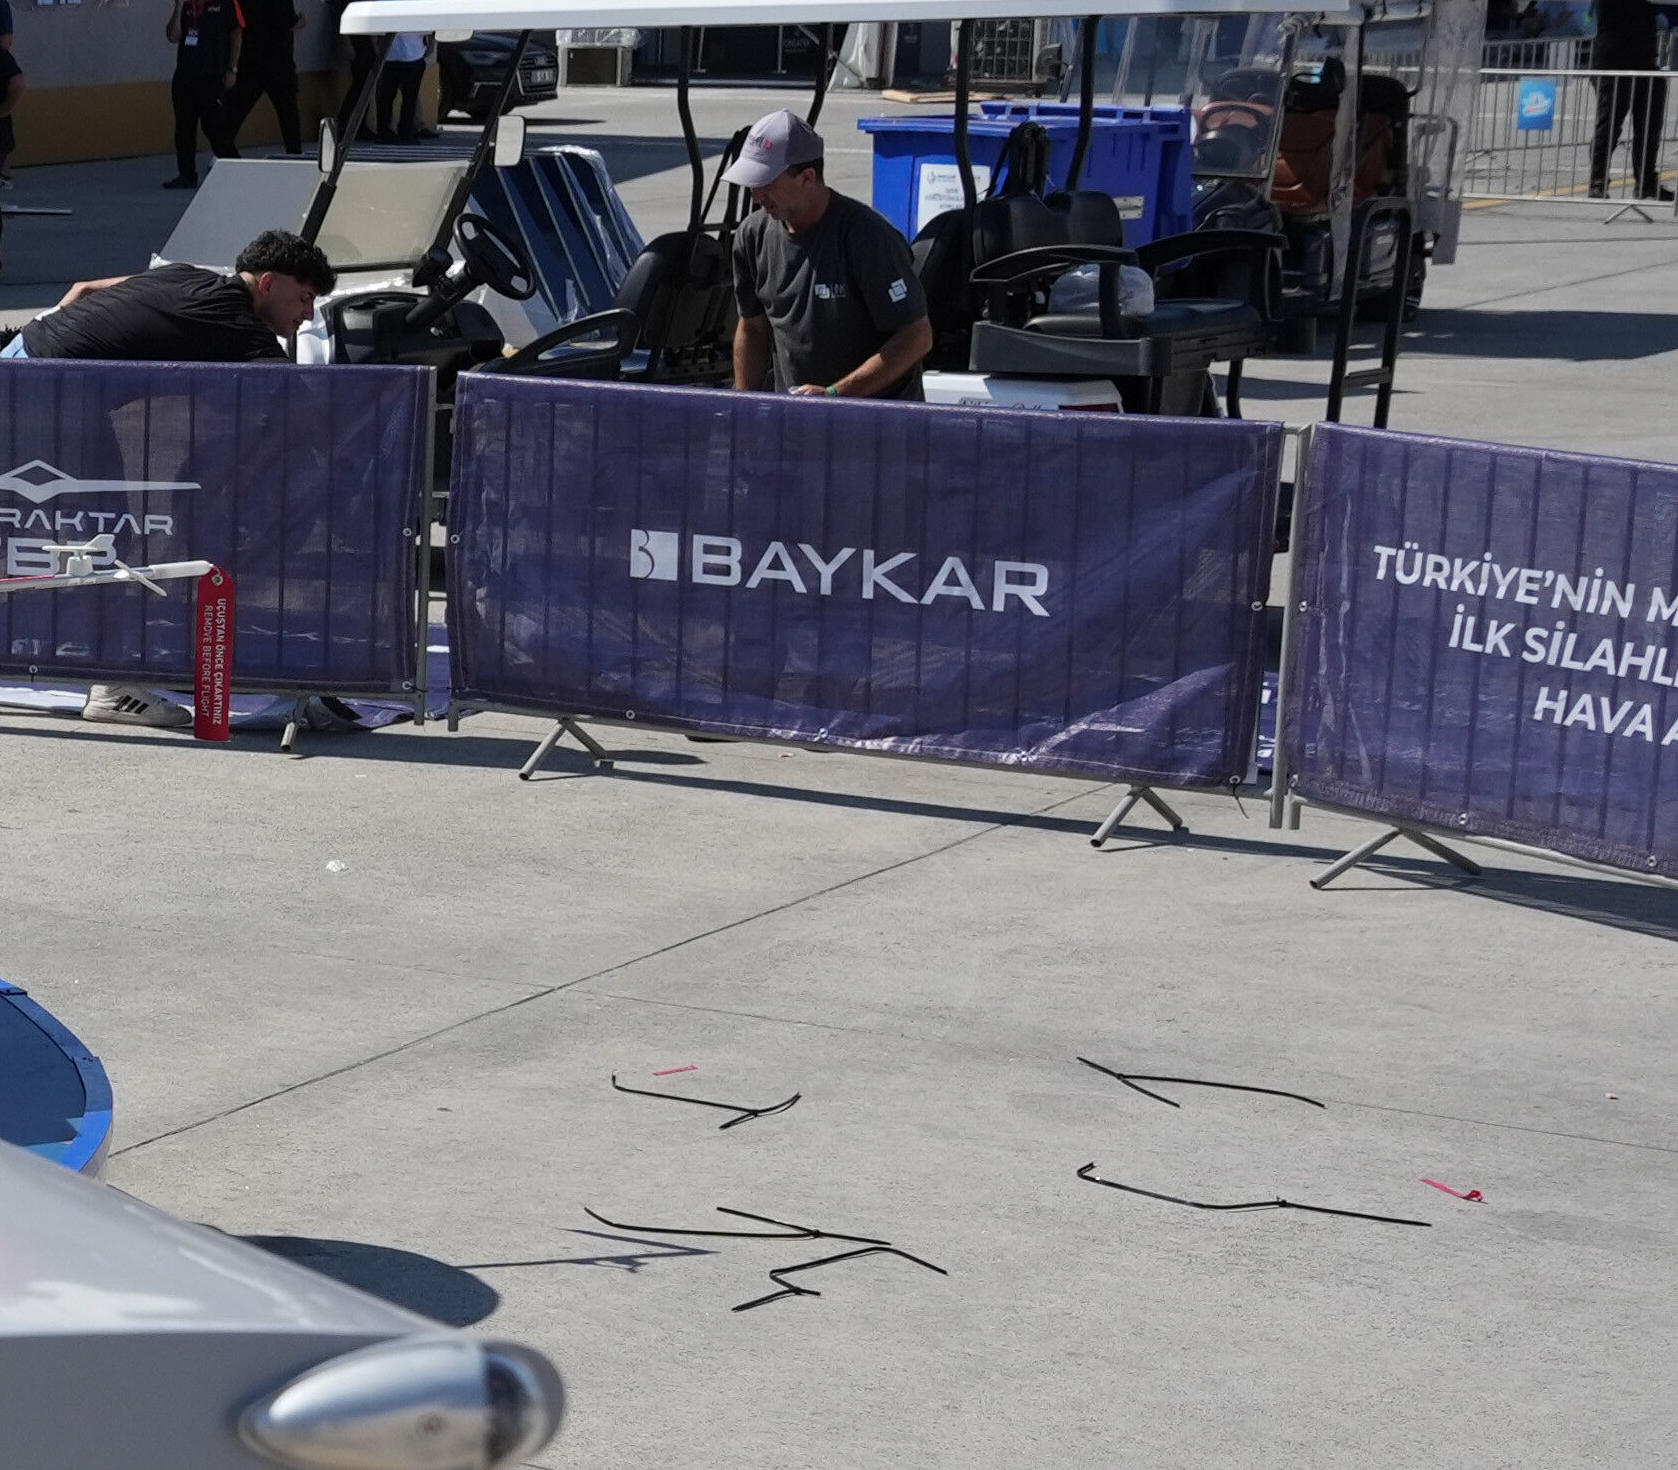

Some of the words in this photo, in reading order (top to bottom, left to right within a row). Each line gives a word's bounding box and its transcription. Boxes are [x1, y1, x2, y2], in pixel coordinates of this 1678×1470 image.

[690, 533, 1049, 620] BAYKAR
[1374, 537, 1635, 623] TÜRKİYE'NİN
[202, 605, 213, 643] REMOVE
[1448, 604, 1513, 660] İLK
[201, 646, 212, 682] BEFORE
[200, 685, 210, 717] FLIGHT
[1533, 685, 1654, 745] HAVA
